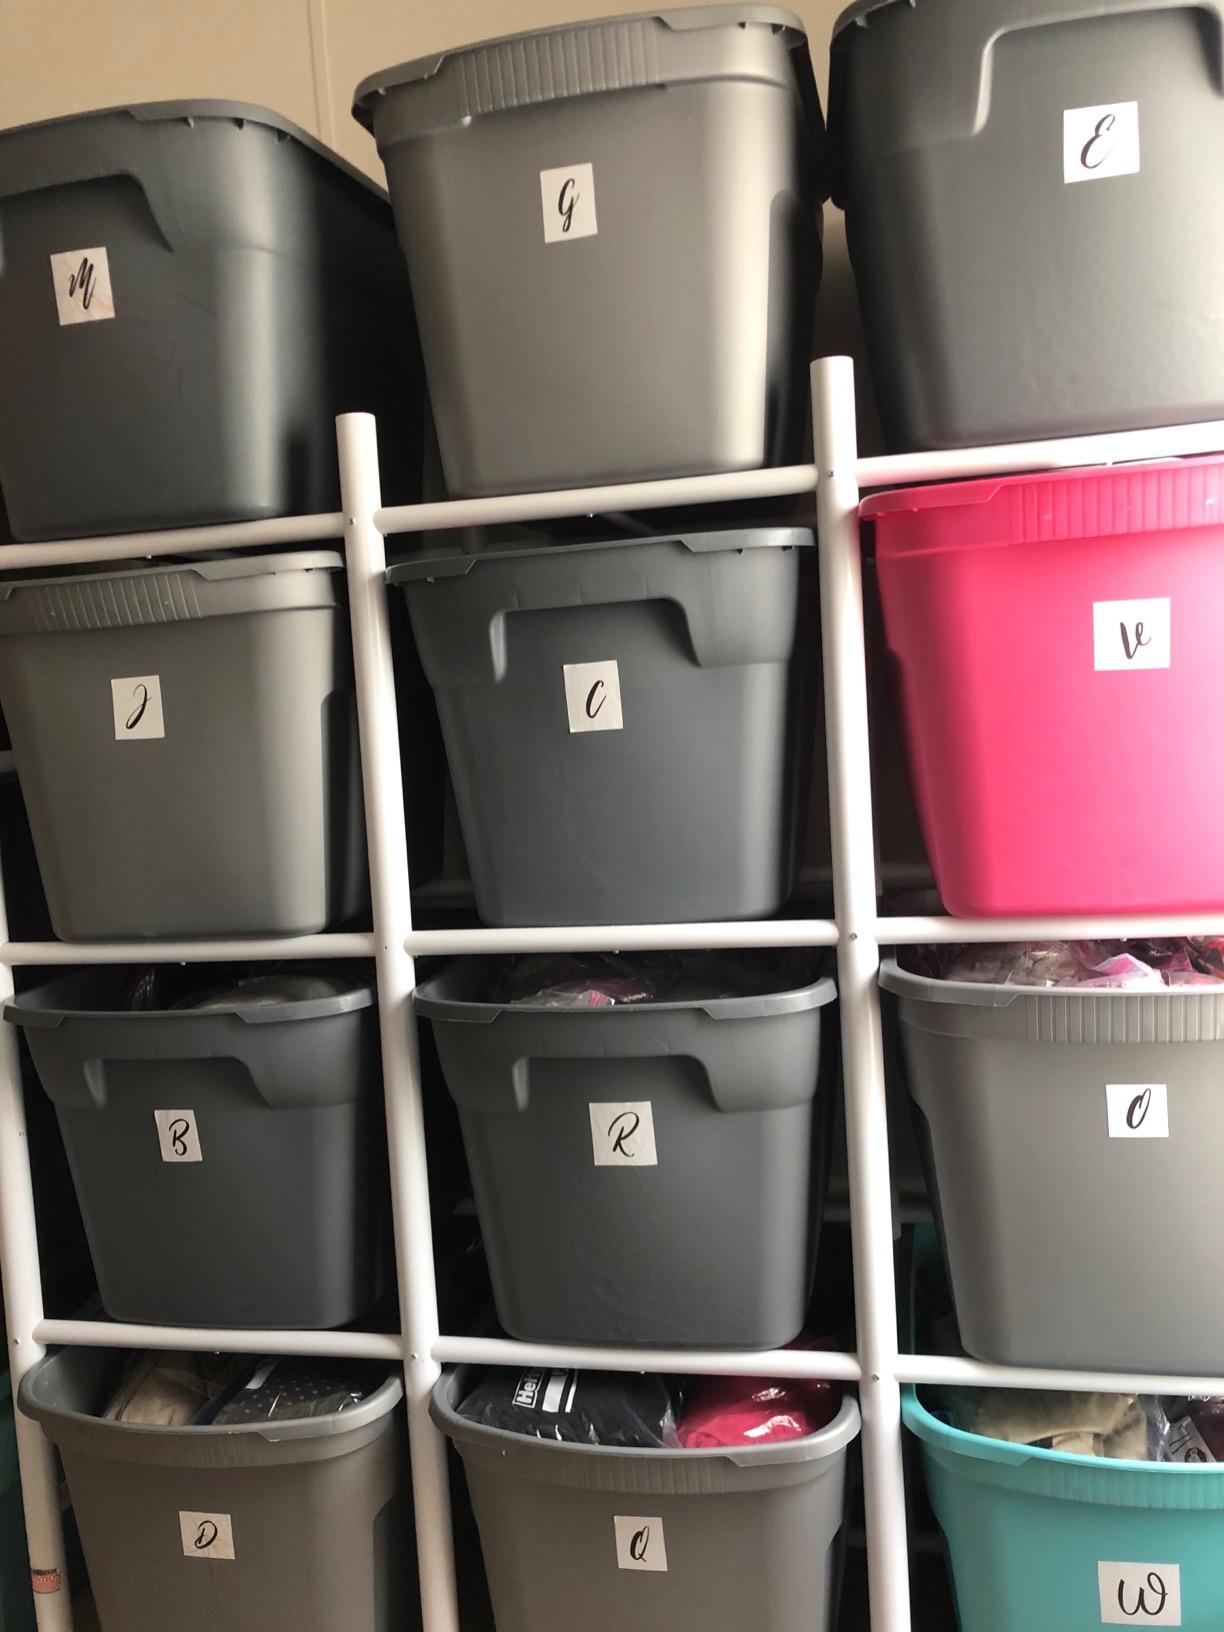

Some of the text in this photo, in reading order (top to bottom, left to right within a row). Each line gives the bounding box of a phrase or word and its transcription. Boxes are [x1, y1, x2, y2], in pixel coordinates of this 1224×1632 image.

[1081, 114, 1116, 169] E
[558, 178, 581, 232] G
[68, 257, 95, 310] M
[126, 684, 152, 729] J
[586, 680, 607, 719] C
[1126, 1088, 1151, 1129] O
[168, 1118, 190, 1157] B
[608, 1111, 640, 1156] R
[194, 1520, 218, 1549] D
[629, 1525, 651, 1563] Q
[1117, 1572, 1169, 1616] W
